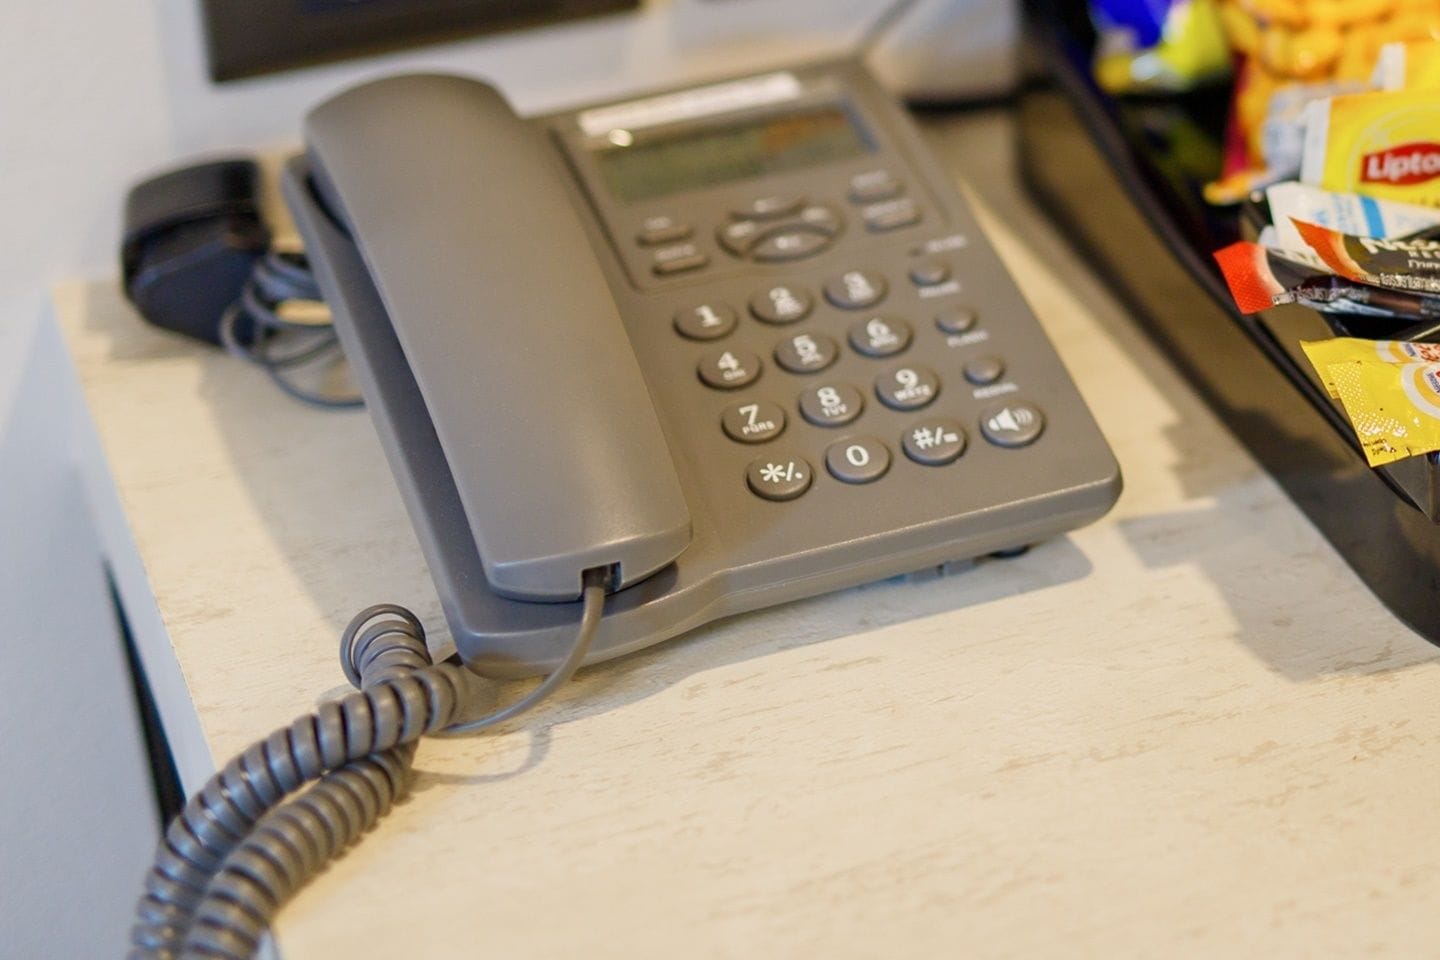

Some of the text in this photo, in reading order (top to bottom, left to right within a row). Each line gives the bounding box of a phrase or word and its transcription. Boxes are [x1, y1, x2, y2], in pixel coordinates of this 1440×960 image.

[696, 305, 721, 327] 1
[866, 318, 890, 339] 6
[793, 334, 817, 356] 5
[718, 352, 740, 371] 4
[895, 369, 918, 390] 9
[816, 387, 840, 407] 8
[739, 404, 759, 426] 7
[846, 445, 869, 467] 0
